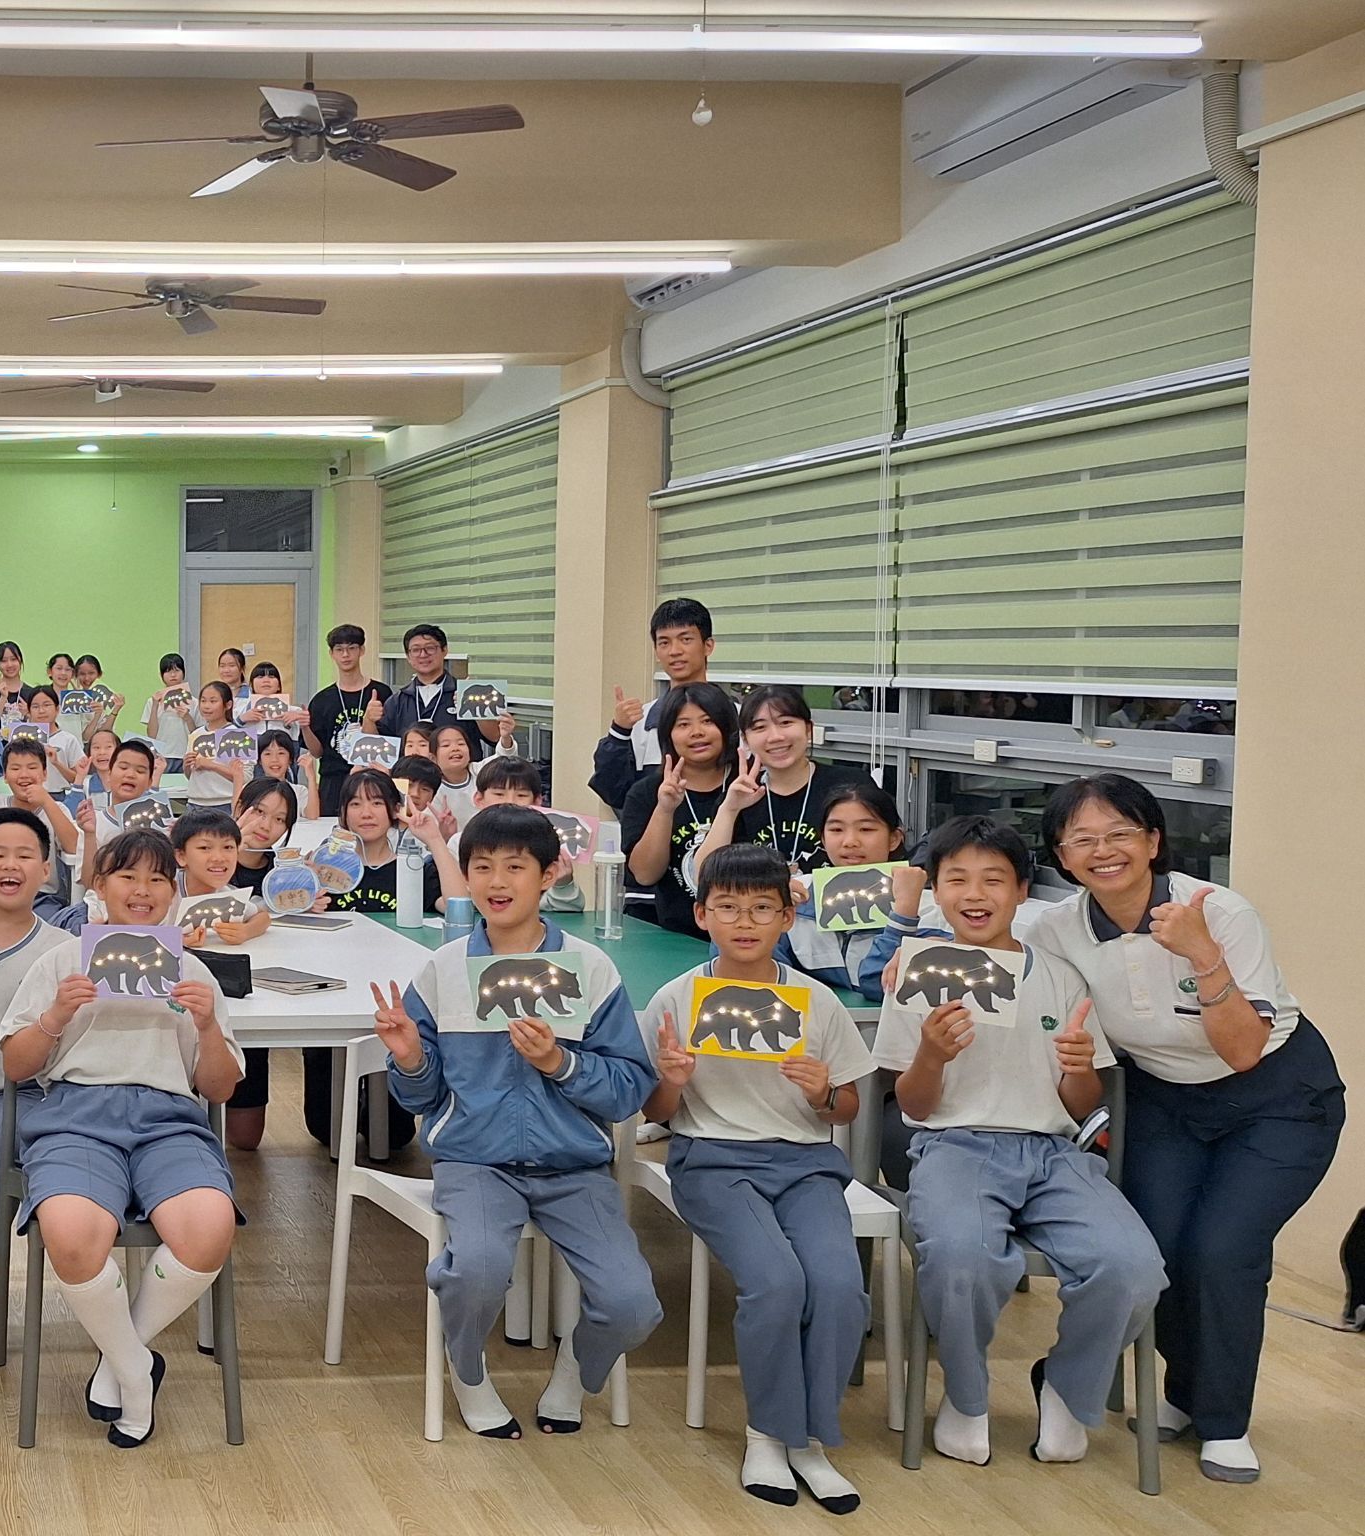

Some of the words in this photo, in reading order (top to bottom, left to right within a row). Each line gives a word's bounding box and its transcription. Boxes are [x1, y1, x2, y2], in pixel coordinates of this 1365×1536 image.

[350, 708, 365, 717] LIG
[337, 889, 363, 908] SKY
[368, 889, 398, 910] LIGH
